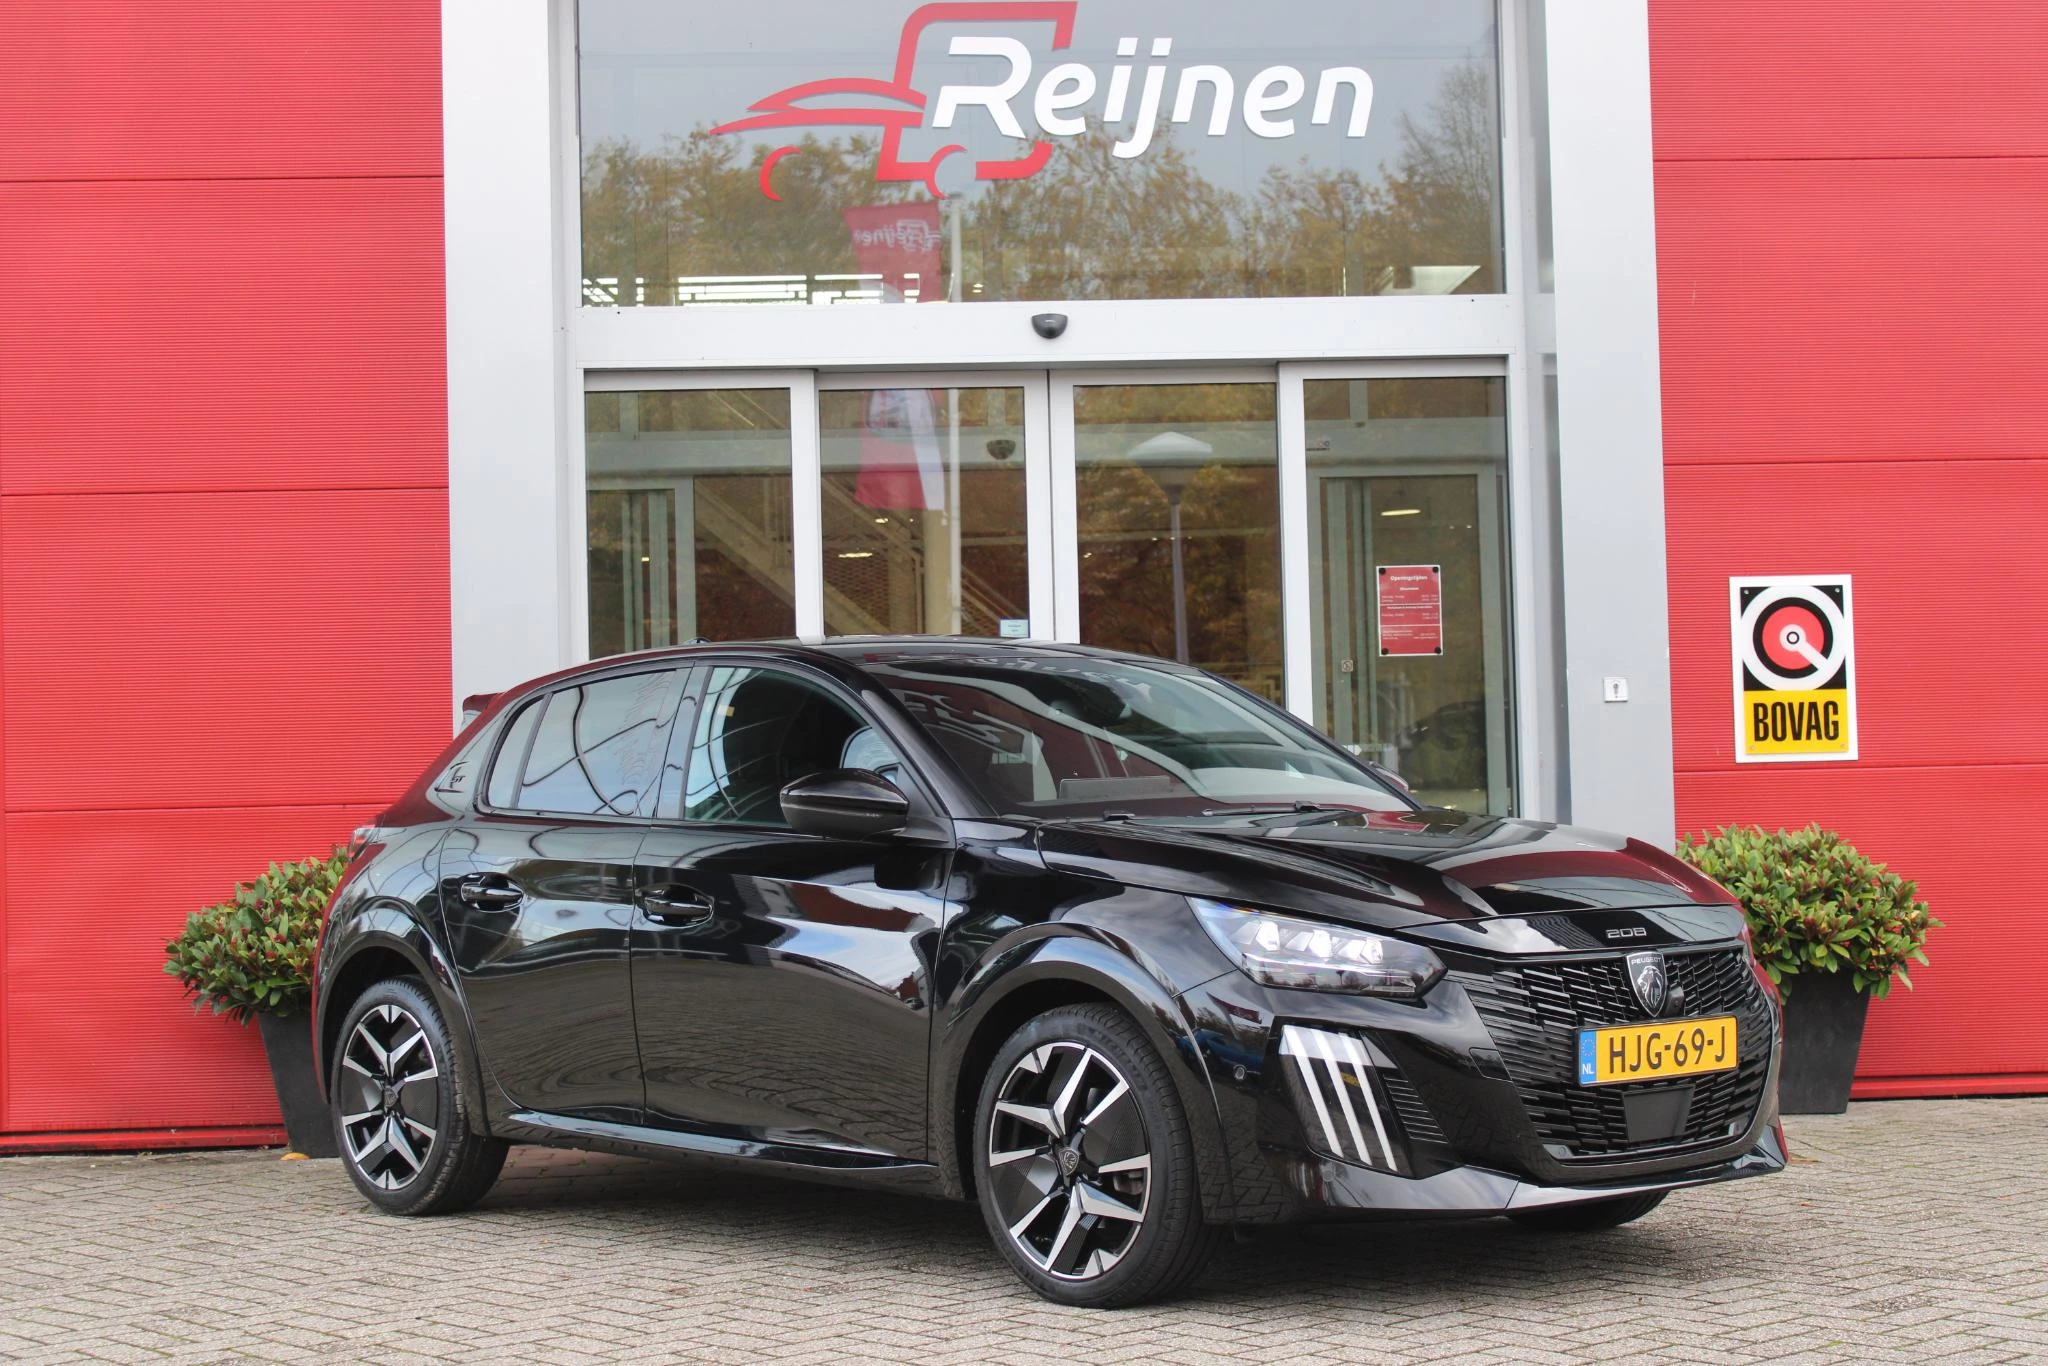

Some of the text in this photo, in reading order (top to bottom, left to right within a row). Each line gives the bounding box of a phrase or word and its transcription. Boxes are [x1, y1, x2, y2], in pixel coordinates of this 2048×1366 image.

[932, 36, 1374, 159] Reijnen
[1753, 701, 1839, 741] BOVAG
[1606, 927, 1647, 938] 208
[1631, 956, 1661, 965] PEUGEOT
[1609, 1026, 1725, 1073] HJG-69-J
[1582, 1062, 1595, 1075] NL
